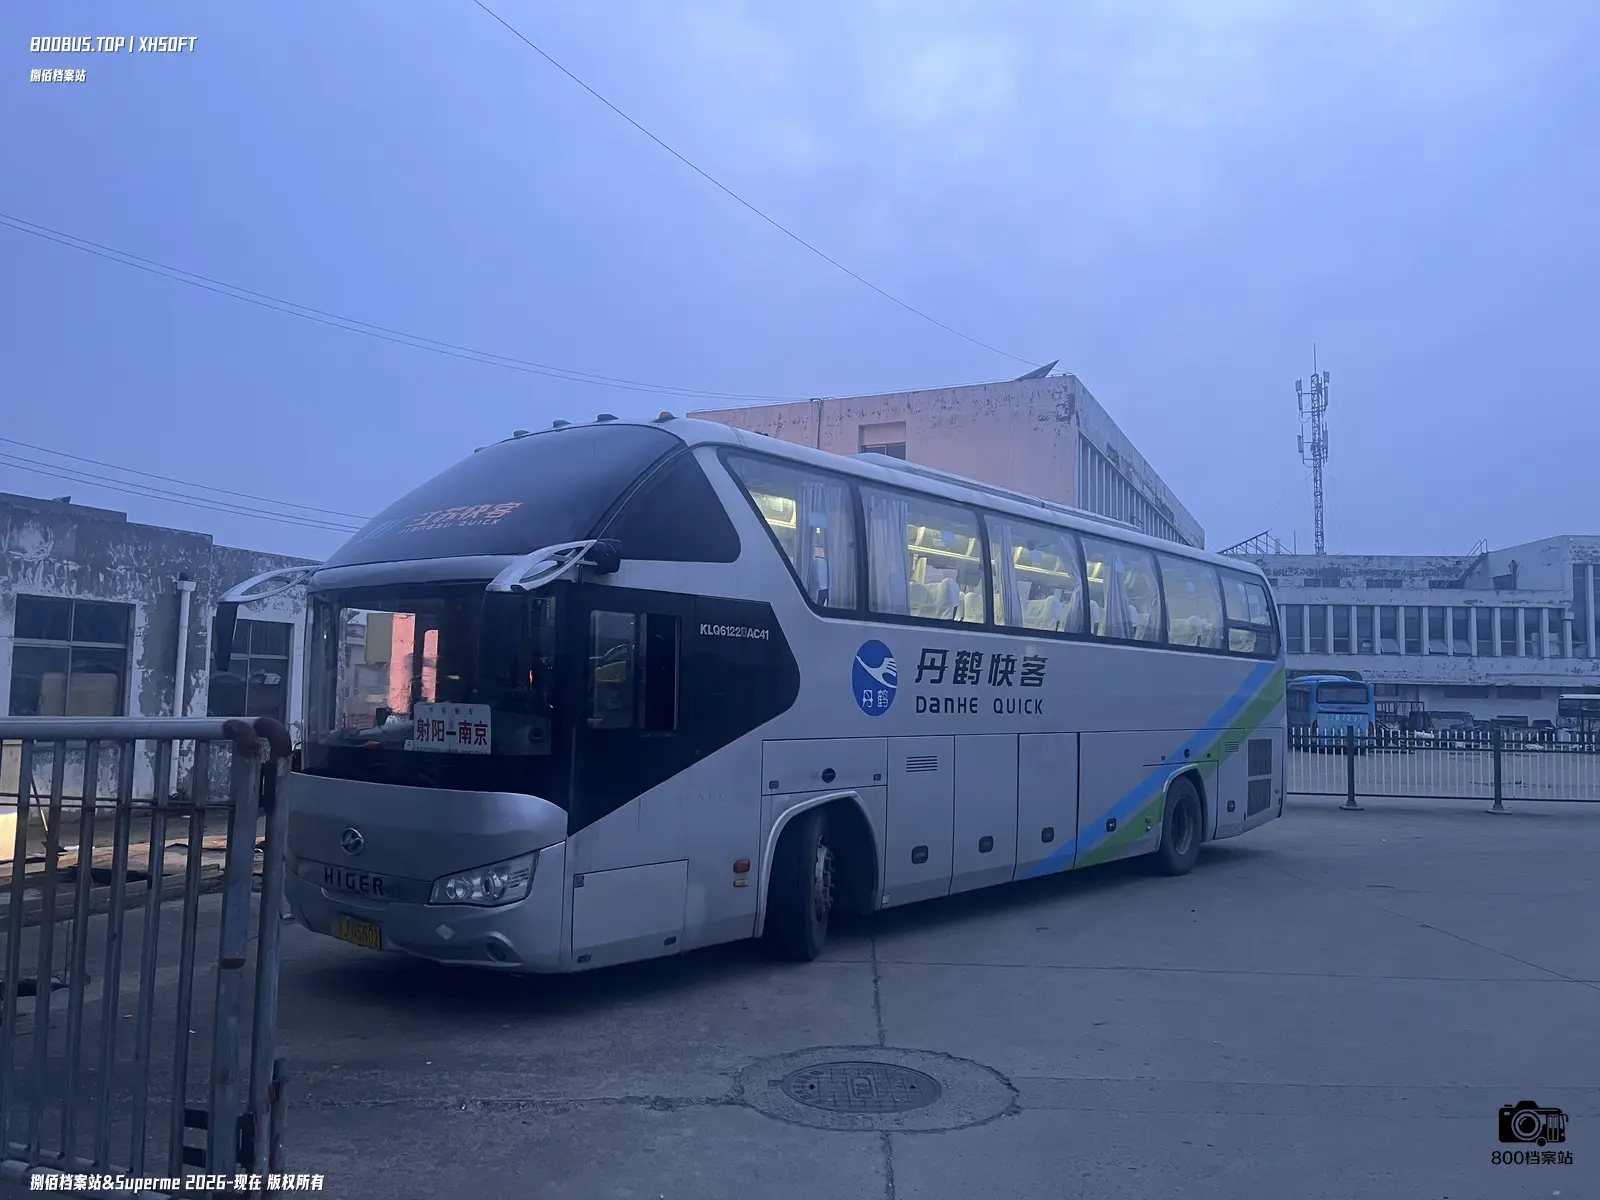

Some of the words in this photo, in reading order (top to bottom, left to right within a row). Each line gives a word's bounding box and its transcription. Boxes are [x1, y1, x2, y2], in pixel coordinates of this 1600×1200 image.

[458, 519, 501, 527] QUICK
[914, 648, 1048, 687] 丹鹤快客
[862, 689, 889, 708] 丹鹤
[993, 698, 1044, 714] QUICK
[324, 866, 384, 896] HIGER
